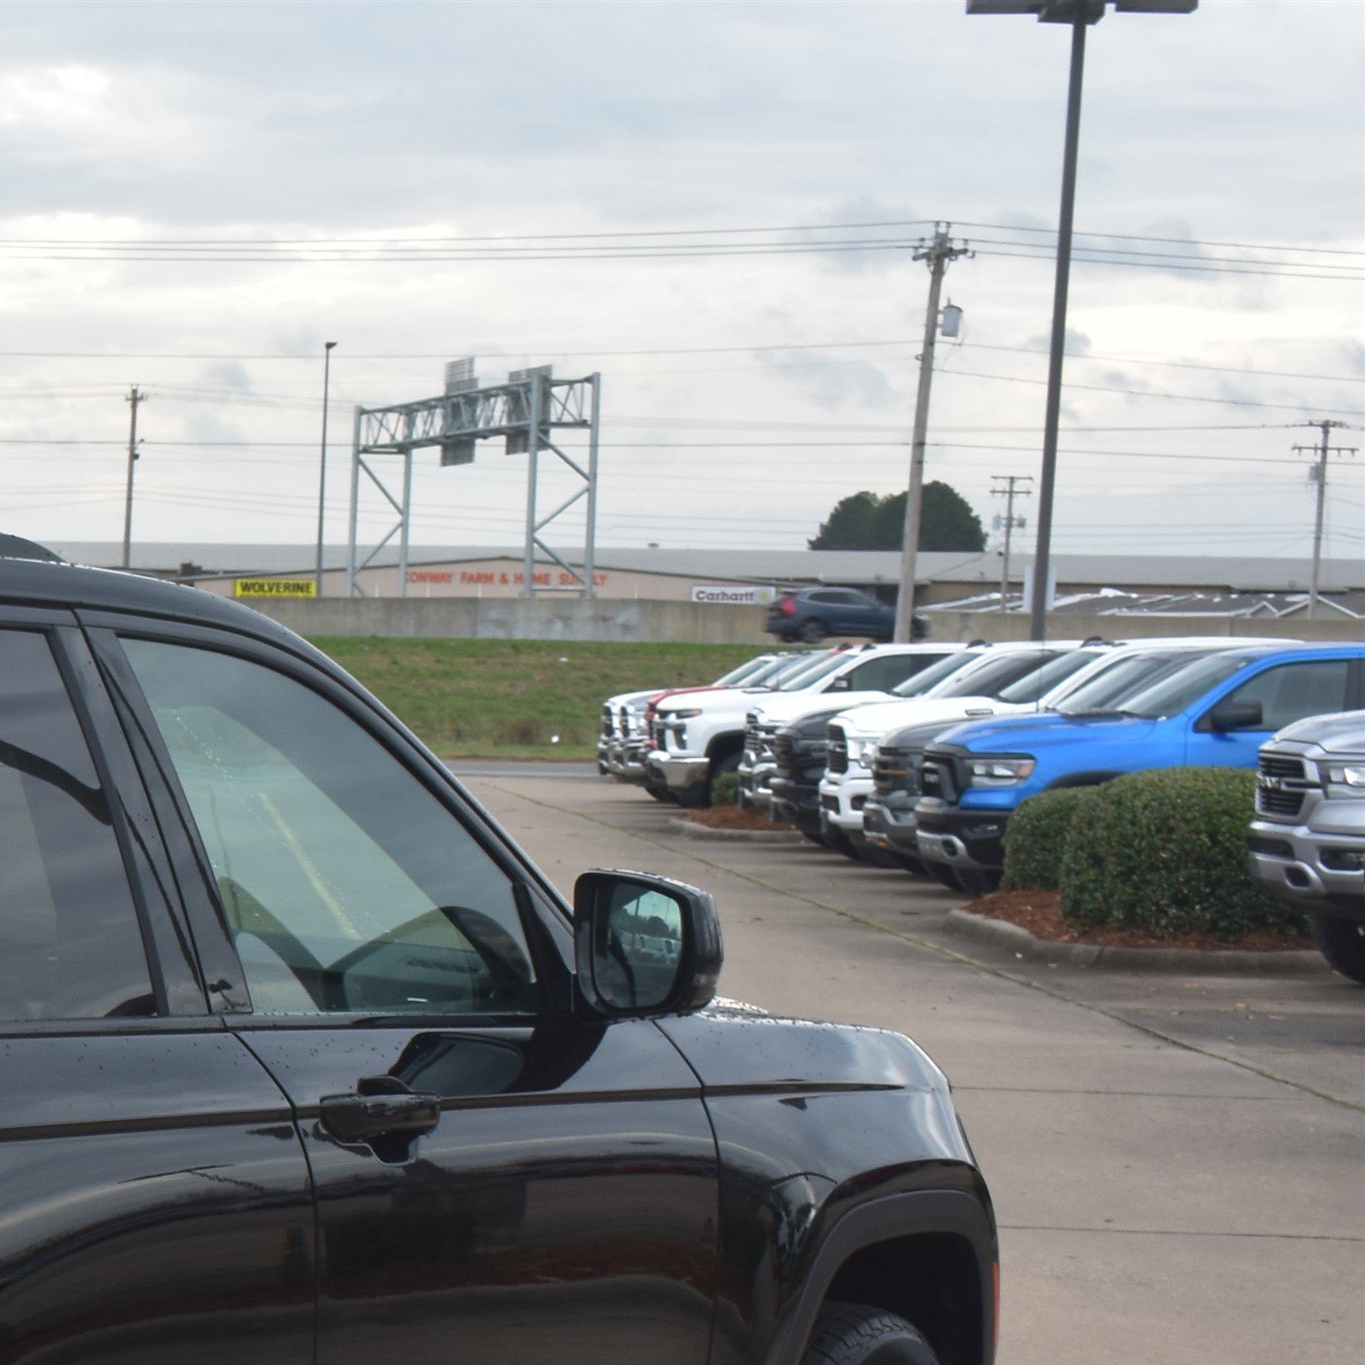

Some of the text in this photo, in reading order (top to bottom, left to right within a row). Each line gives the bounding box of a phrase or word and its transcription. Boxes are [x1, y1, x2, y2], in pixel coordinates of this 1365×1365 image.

[405, 571, 608, 586] ONWAY FARM & HME SULY
[240, 581, 312, 594] WOLVERINE
[696, 590, 754, 601] Carhartt
